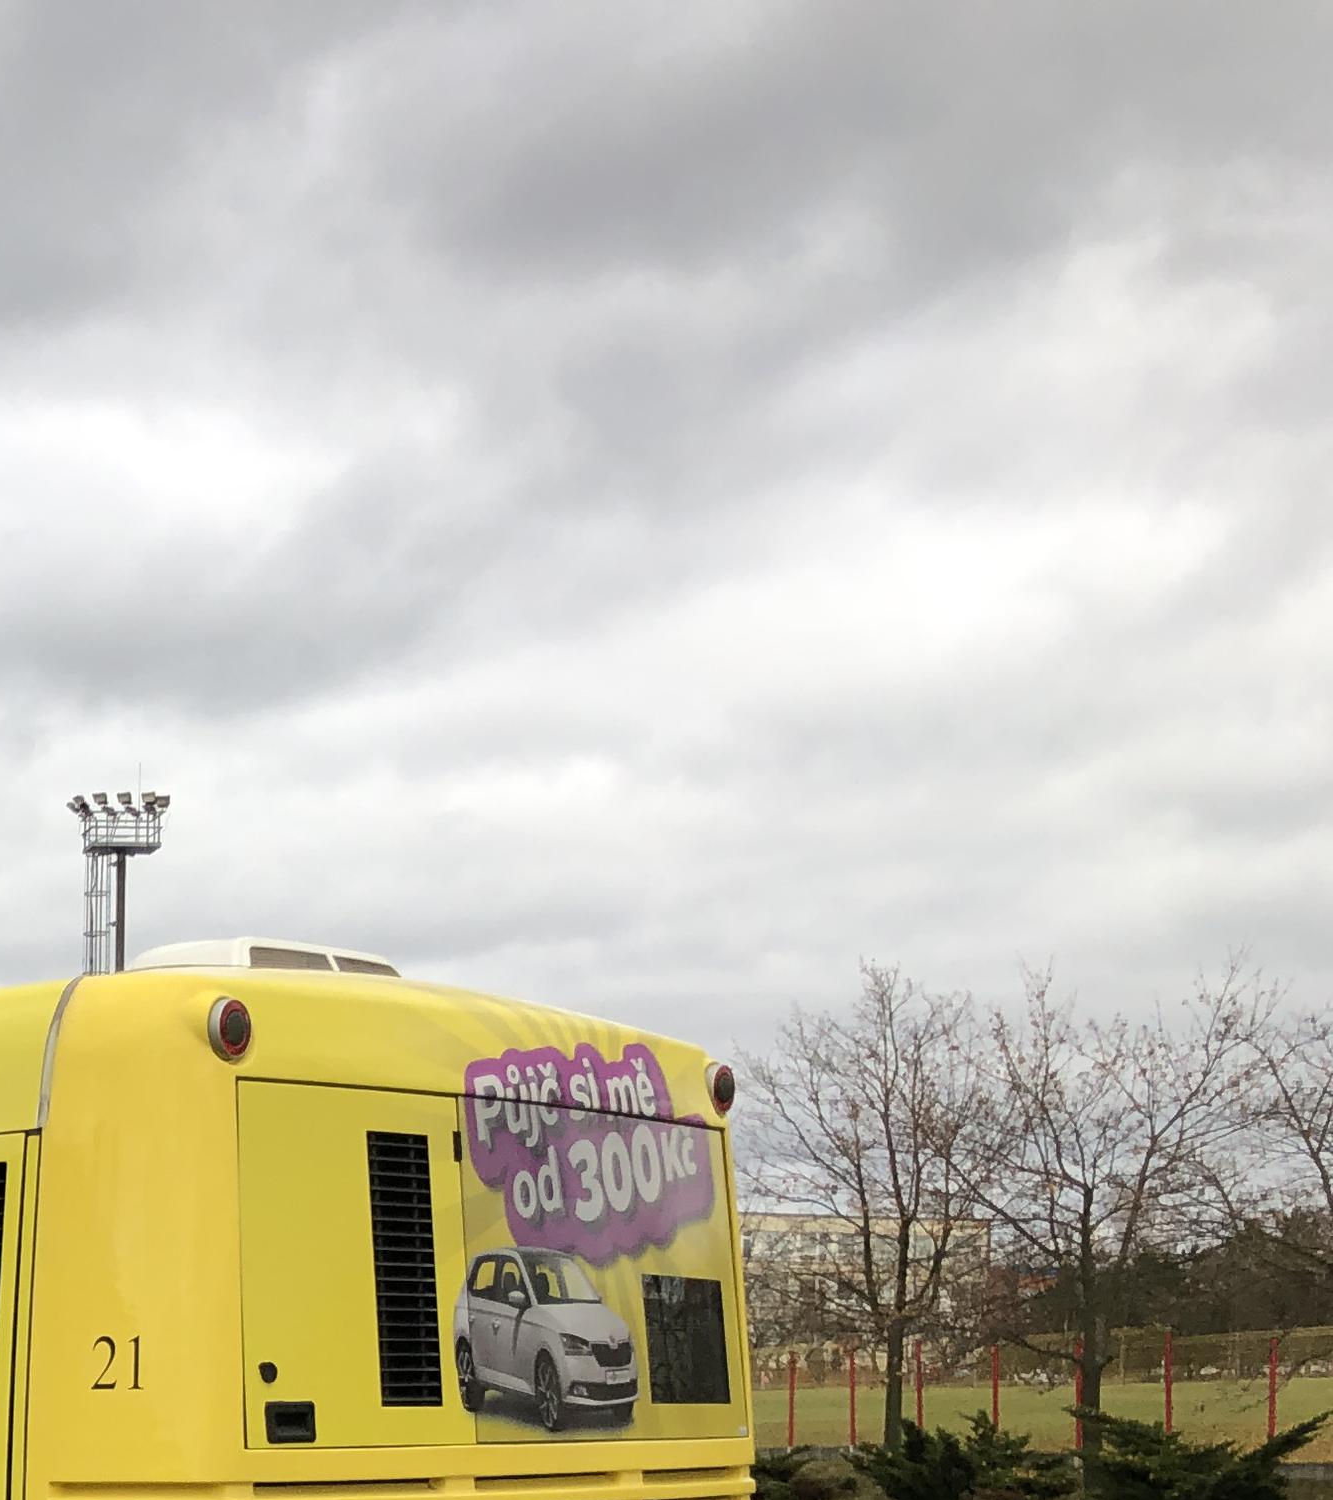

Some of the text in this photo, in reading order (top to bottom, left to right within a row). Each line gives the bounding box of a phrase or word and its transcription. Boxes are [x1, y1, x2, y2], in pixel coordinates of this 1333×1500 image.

[473, 1057, 656, 1149] Půjč si mě
[512, 1145, 564, 1219] od
[568, 1124, 662, 1222] 300
[91, 1335, 144, 1390] 21
